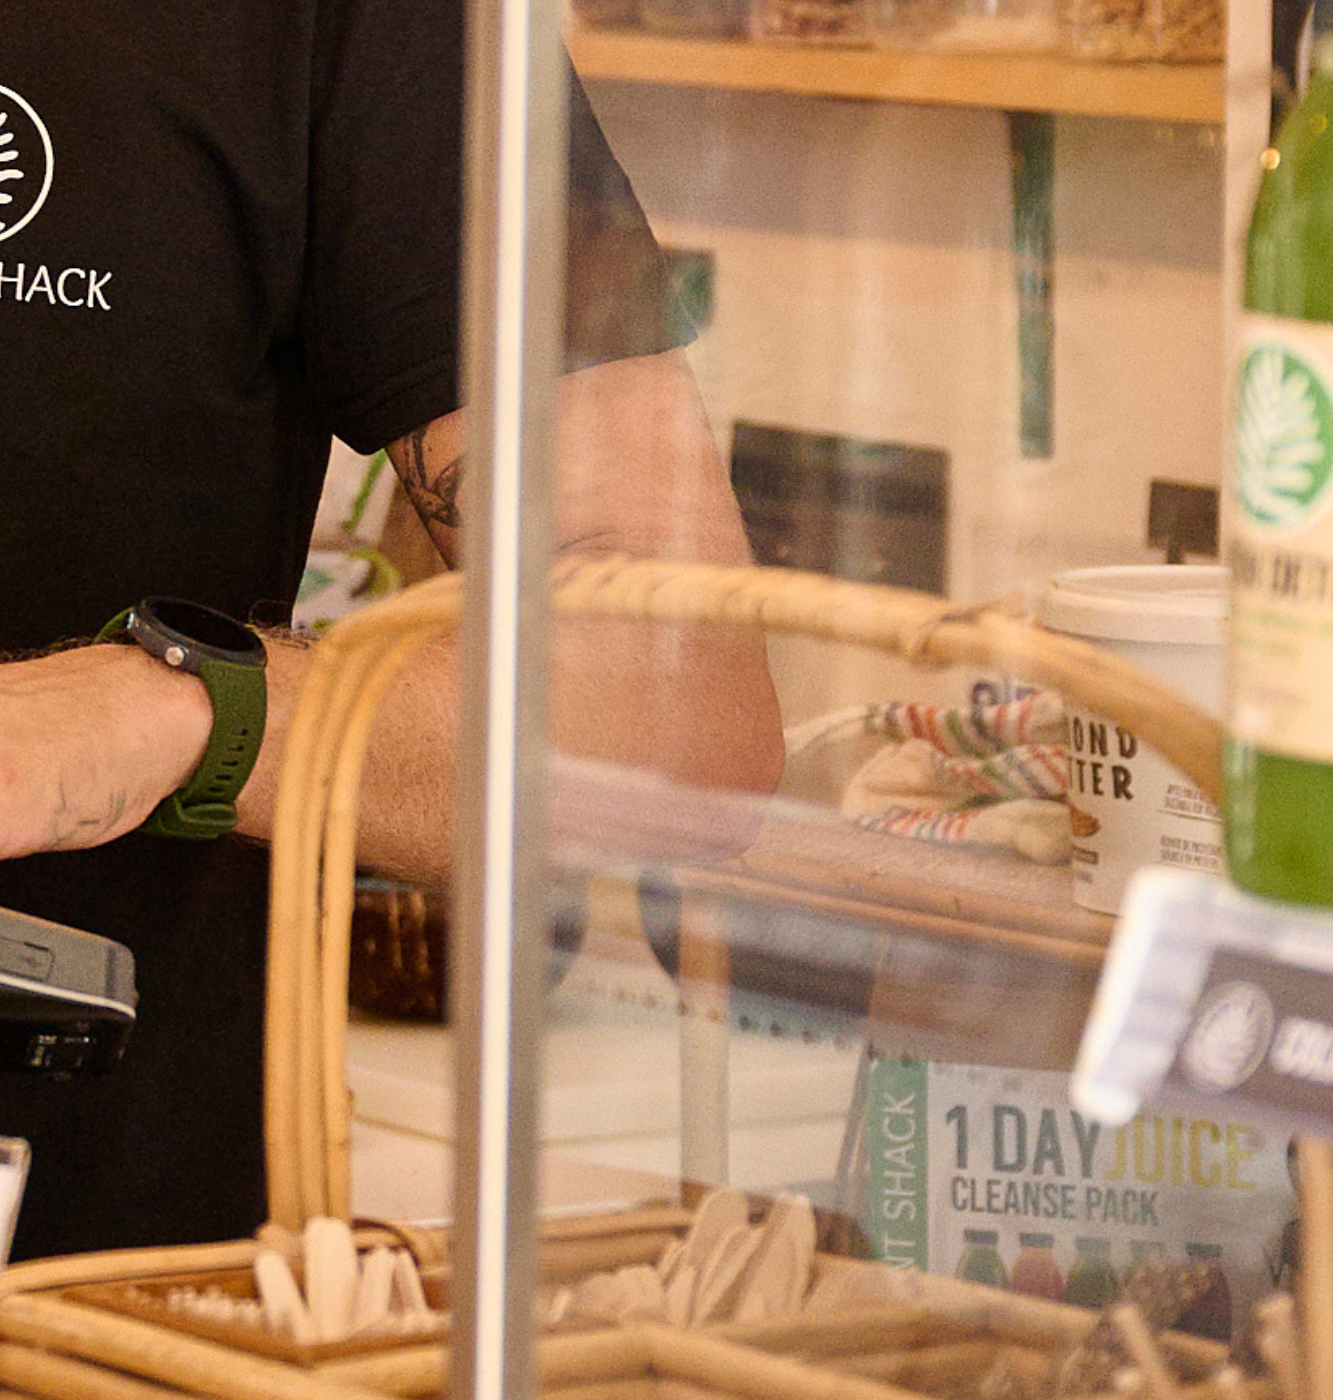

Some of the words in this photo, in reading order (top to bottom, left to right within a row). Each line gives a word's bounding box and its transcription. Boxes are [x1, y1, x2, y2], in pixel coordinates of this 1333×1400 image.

[883, 1092, 917, 1221] SHACK
[945, 1105, 970, 1170] 1
[993, 1105, 1104, 1180] DAY
[1105, 1113, 1258, 1190] JUICE
[951, 1175, 1075, 1220] CLEANSE
[1085, 1186, 1160, 1227] PACK
